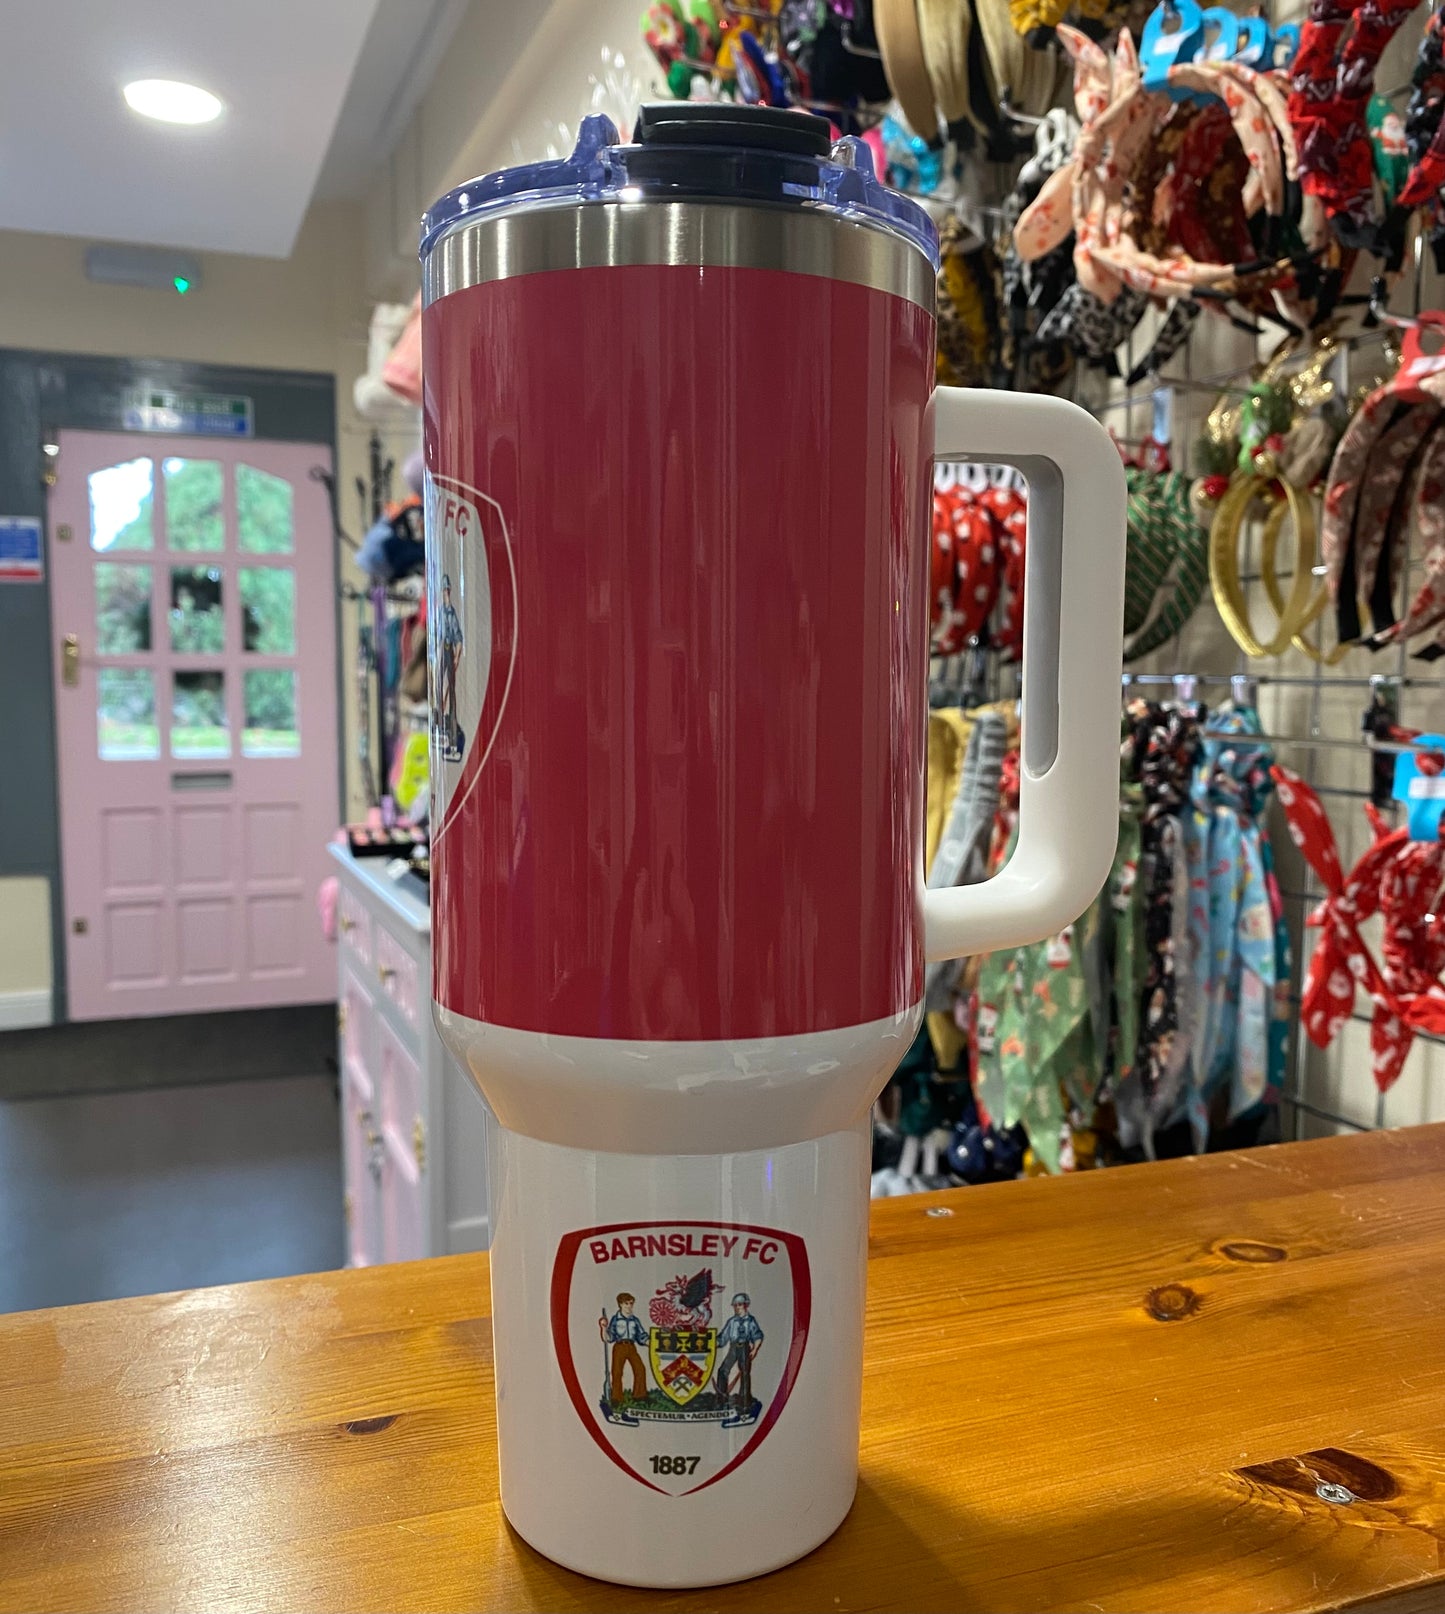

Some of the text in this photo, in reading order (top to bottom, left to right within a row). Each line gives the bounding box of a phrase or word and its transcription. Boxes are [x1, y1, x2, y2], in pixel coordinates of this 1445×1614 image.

[444, 499, 470, 536] FC
[589, 1234, 778, 1264] BARNSLEY FC
[649, 1455, 701, 1475] 1887
